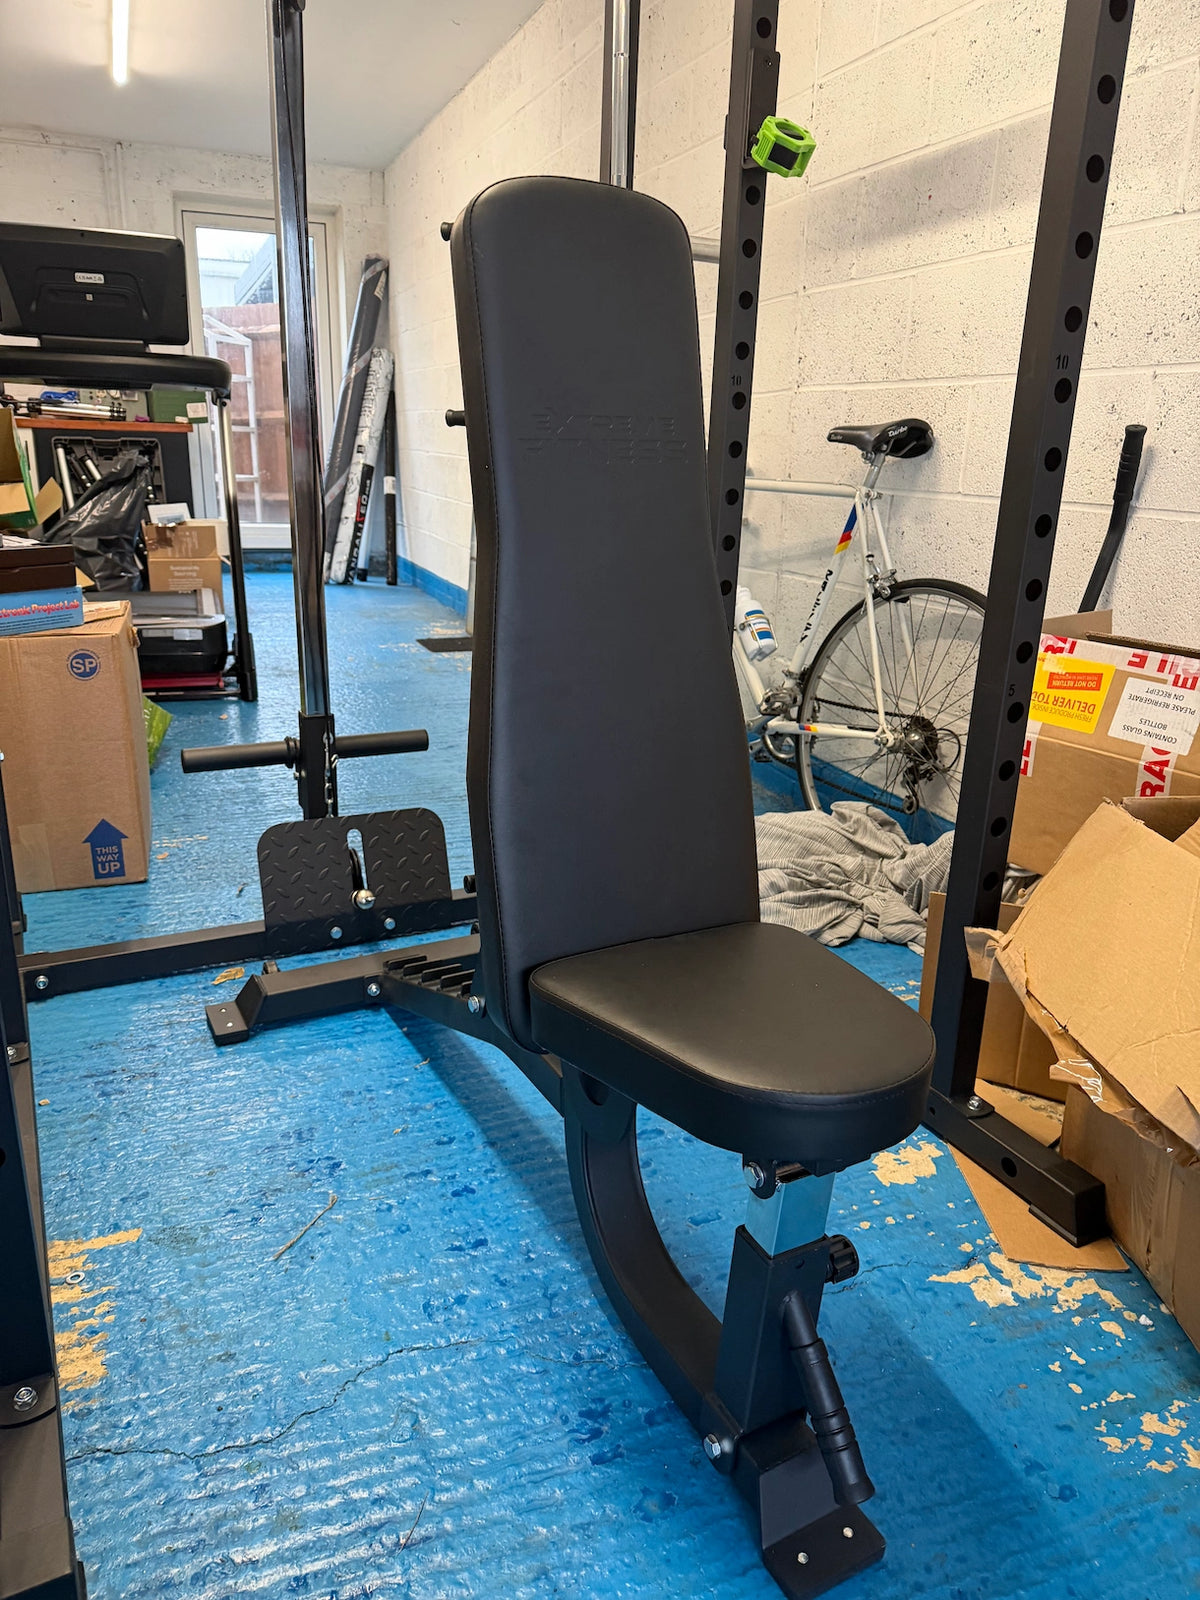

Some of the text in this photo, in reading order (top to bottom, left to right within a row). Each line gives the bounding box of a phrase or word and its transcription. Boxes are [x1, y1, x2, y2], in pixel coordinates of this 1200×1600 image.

[1056, 354, 1069, 370] 10
[731, 375, 742, 386] 10
[888, 425, 908, 437] Turbo
[31, 602, 64, 615] Project
[65, 600, 79, 610] Lab
[72, 658, 97, 673] SP
[1008, 684, 1016, 697] 5
[1145, 687, 1185, 702] ON RECEIPT
[1052, 695, 1096, 715] DELIVER
[1128, 693, 1197, 716] PLEASE REFRIGERATE
[1031, 703, 1093, 723] FRESH PRODUCE INSIDE
[1139, 718, 1168, 731] BOTTLES
[1122, 724, 1178, 744] CONTAINS GLASS
[95, 846, 118, 854] THIS
[96, 853, 119, 862] WAY
[98, 862, 120, 874] UP
